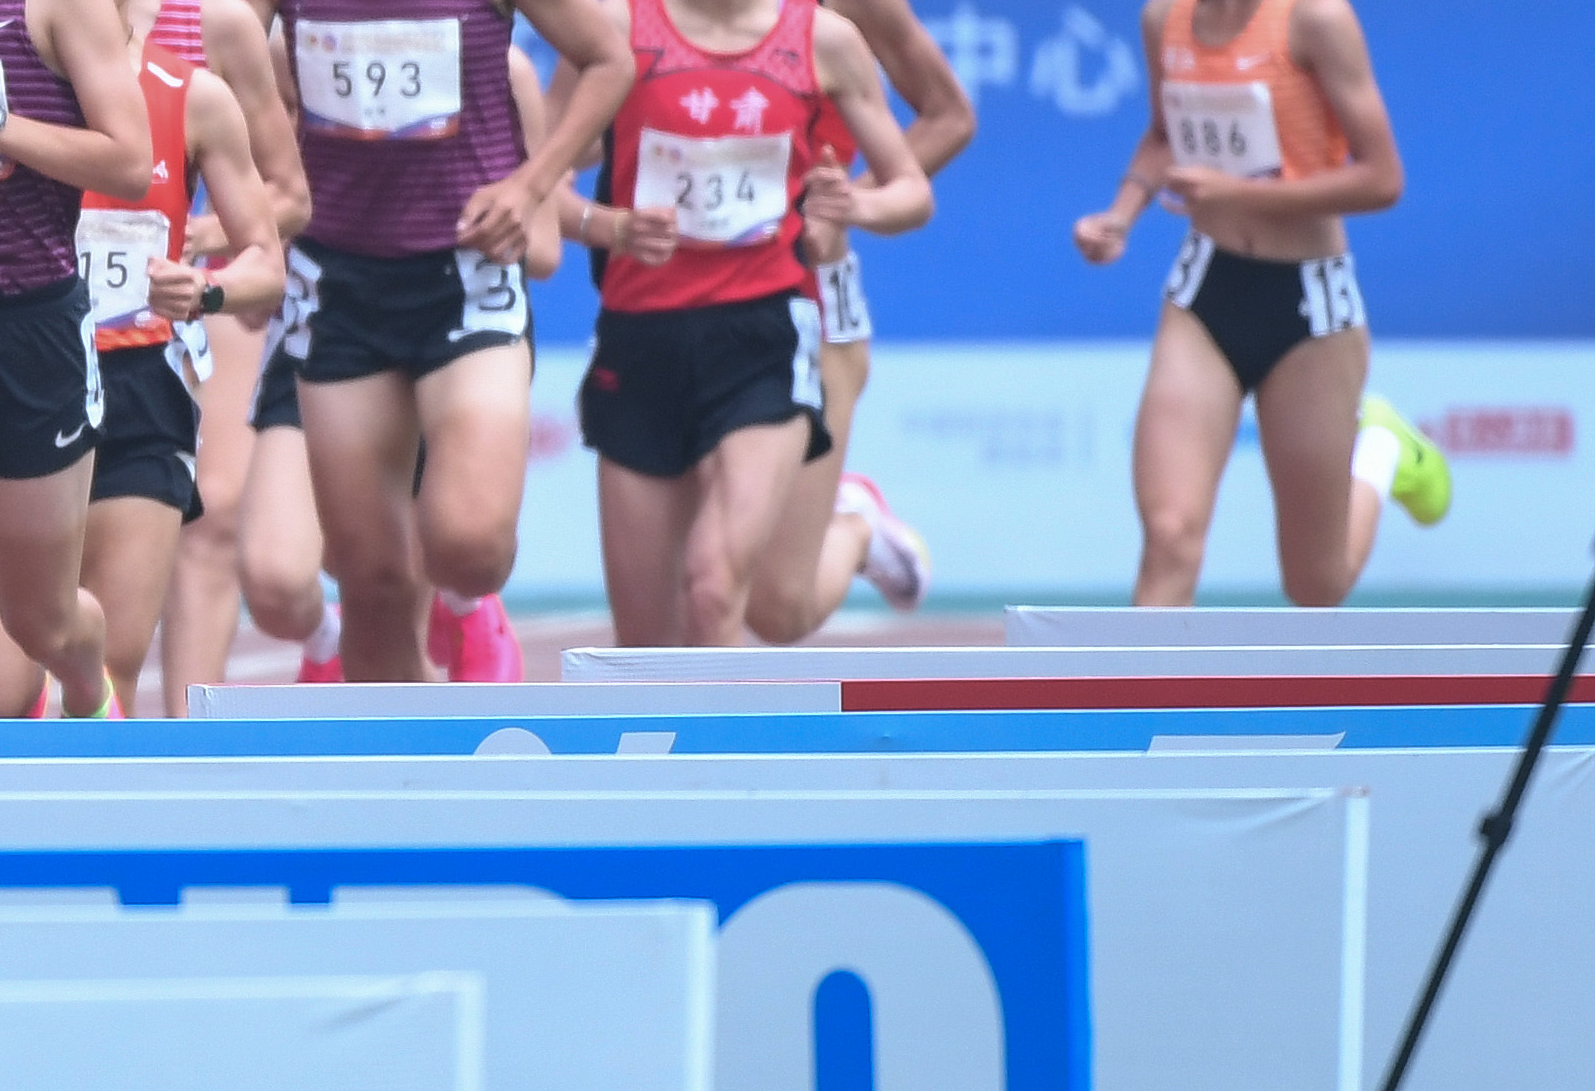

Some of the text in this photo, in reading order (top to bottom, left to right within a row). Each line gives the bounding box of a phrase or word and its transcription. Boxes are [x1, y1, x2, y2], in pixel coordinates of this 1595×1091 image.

[332, 61, 422, 98] 593
[1179, 115, 1247, 158] 886
[675, 171, 755, 210] 234
